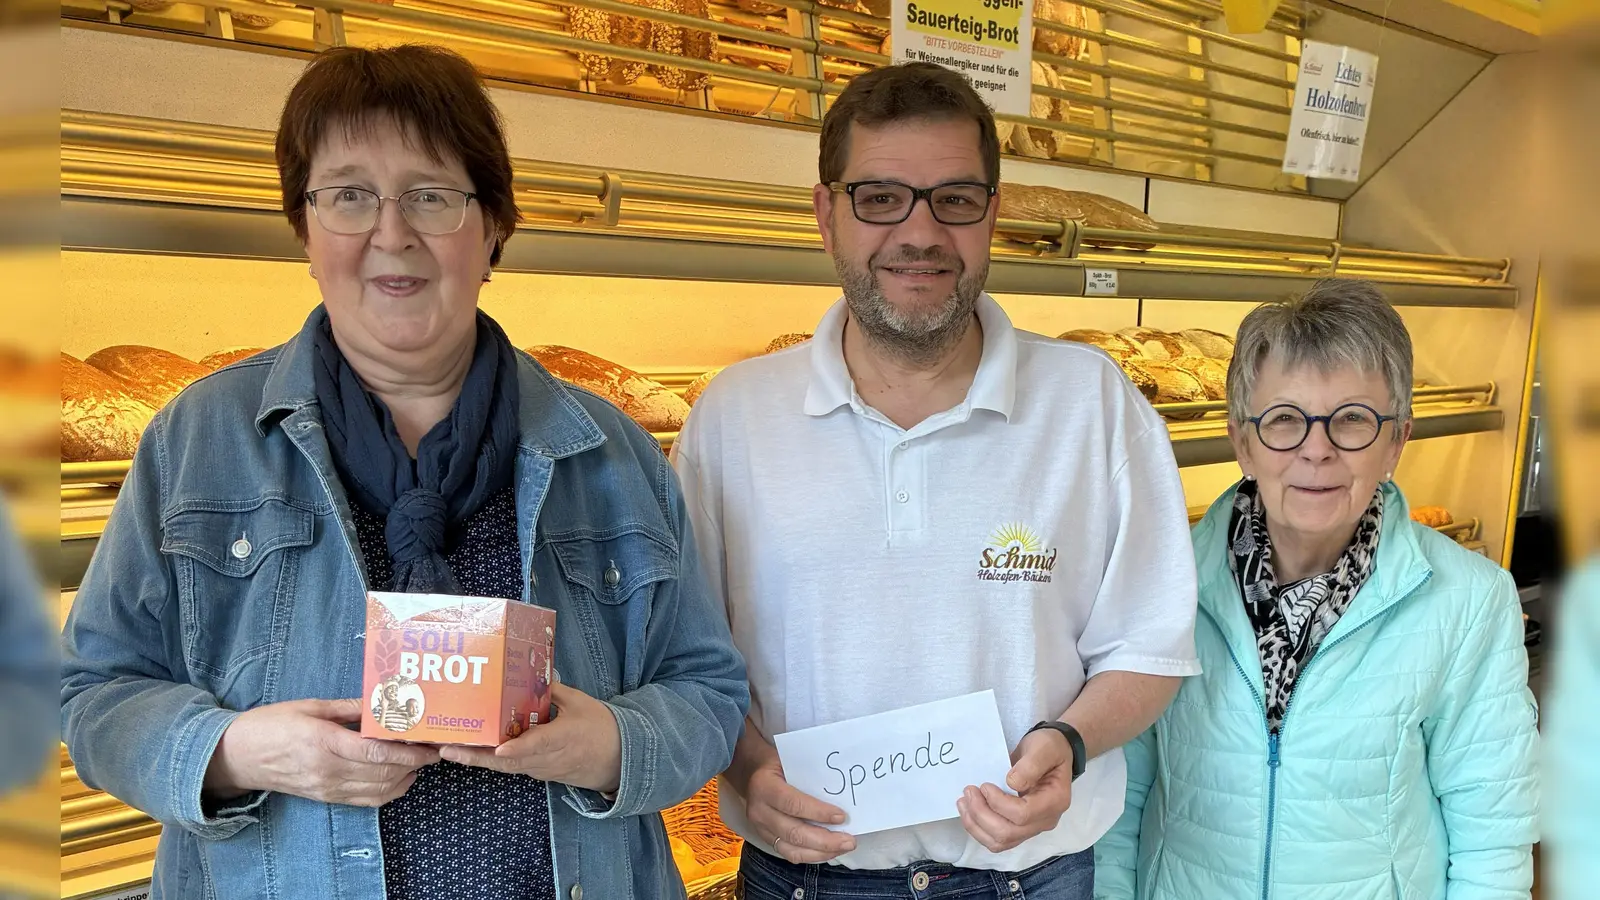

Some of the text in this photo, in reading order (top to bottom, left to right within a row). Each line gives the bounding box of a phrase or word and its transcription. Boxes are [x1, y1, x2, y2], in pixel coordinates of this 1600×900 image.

[906, 3, 1020, 44] Sauerteig-Brot
[905, 48, 1020, 78] für Weizenallergiker und für die
[974, 79, 1007, 92] geeignet
[979, 546, 1057, 571] Schmid
[401, 627, 465, 655] SOLI
[400, 651, 489, 685] BROT
[426, 714, 485, 729] misereor
[823, 731, 960, 806] Spende
